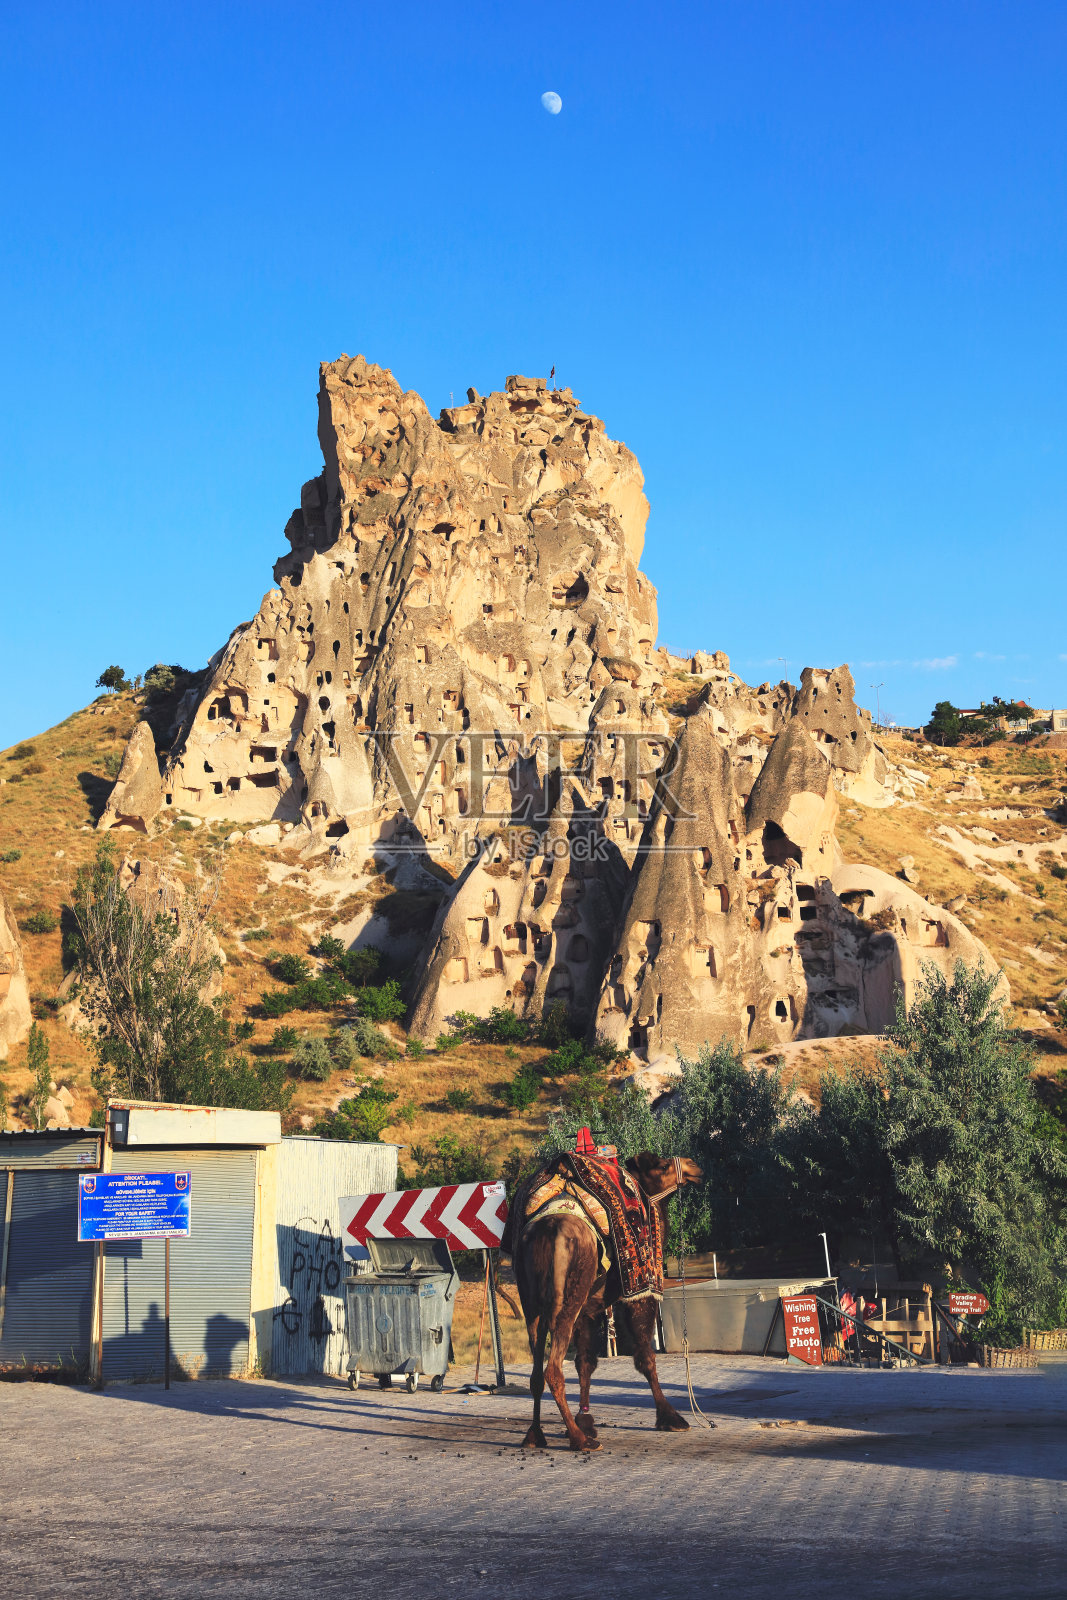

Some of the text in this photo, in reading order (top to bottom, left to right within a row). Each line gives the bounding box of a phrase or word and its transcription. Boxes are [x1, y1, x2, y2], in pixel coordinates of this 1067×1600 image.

[785, 1303, 816, 1313] Wishing
[793, 1315, 811, 1323] Tree
[792, 1326, 815, 1336] Free
[789, 1337, 820, 1348] Photo
